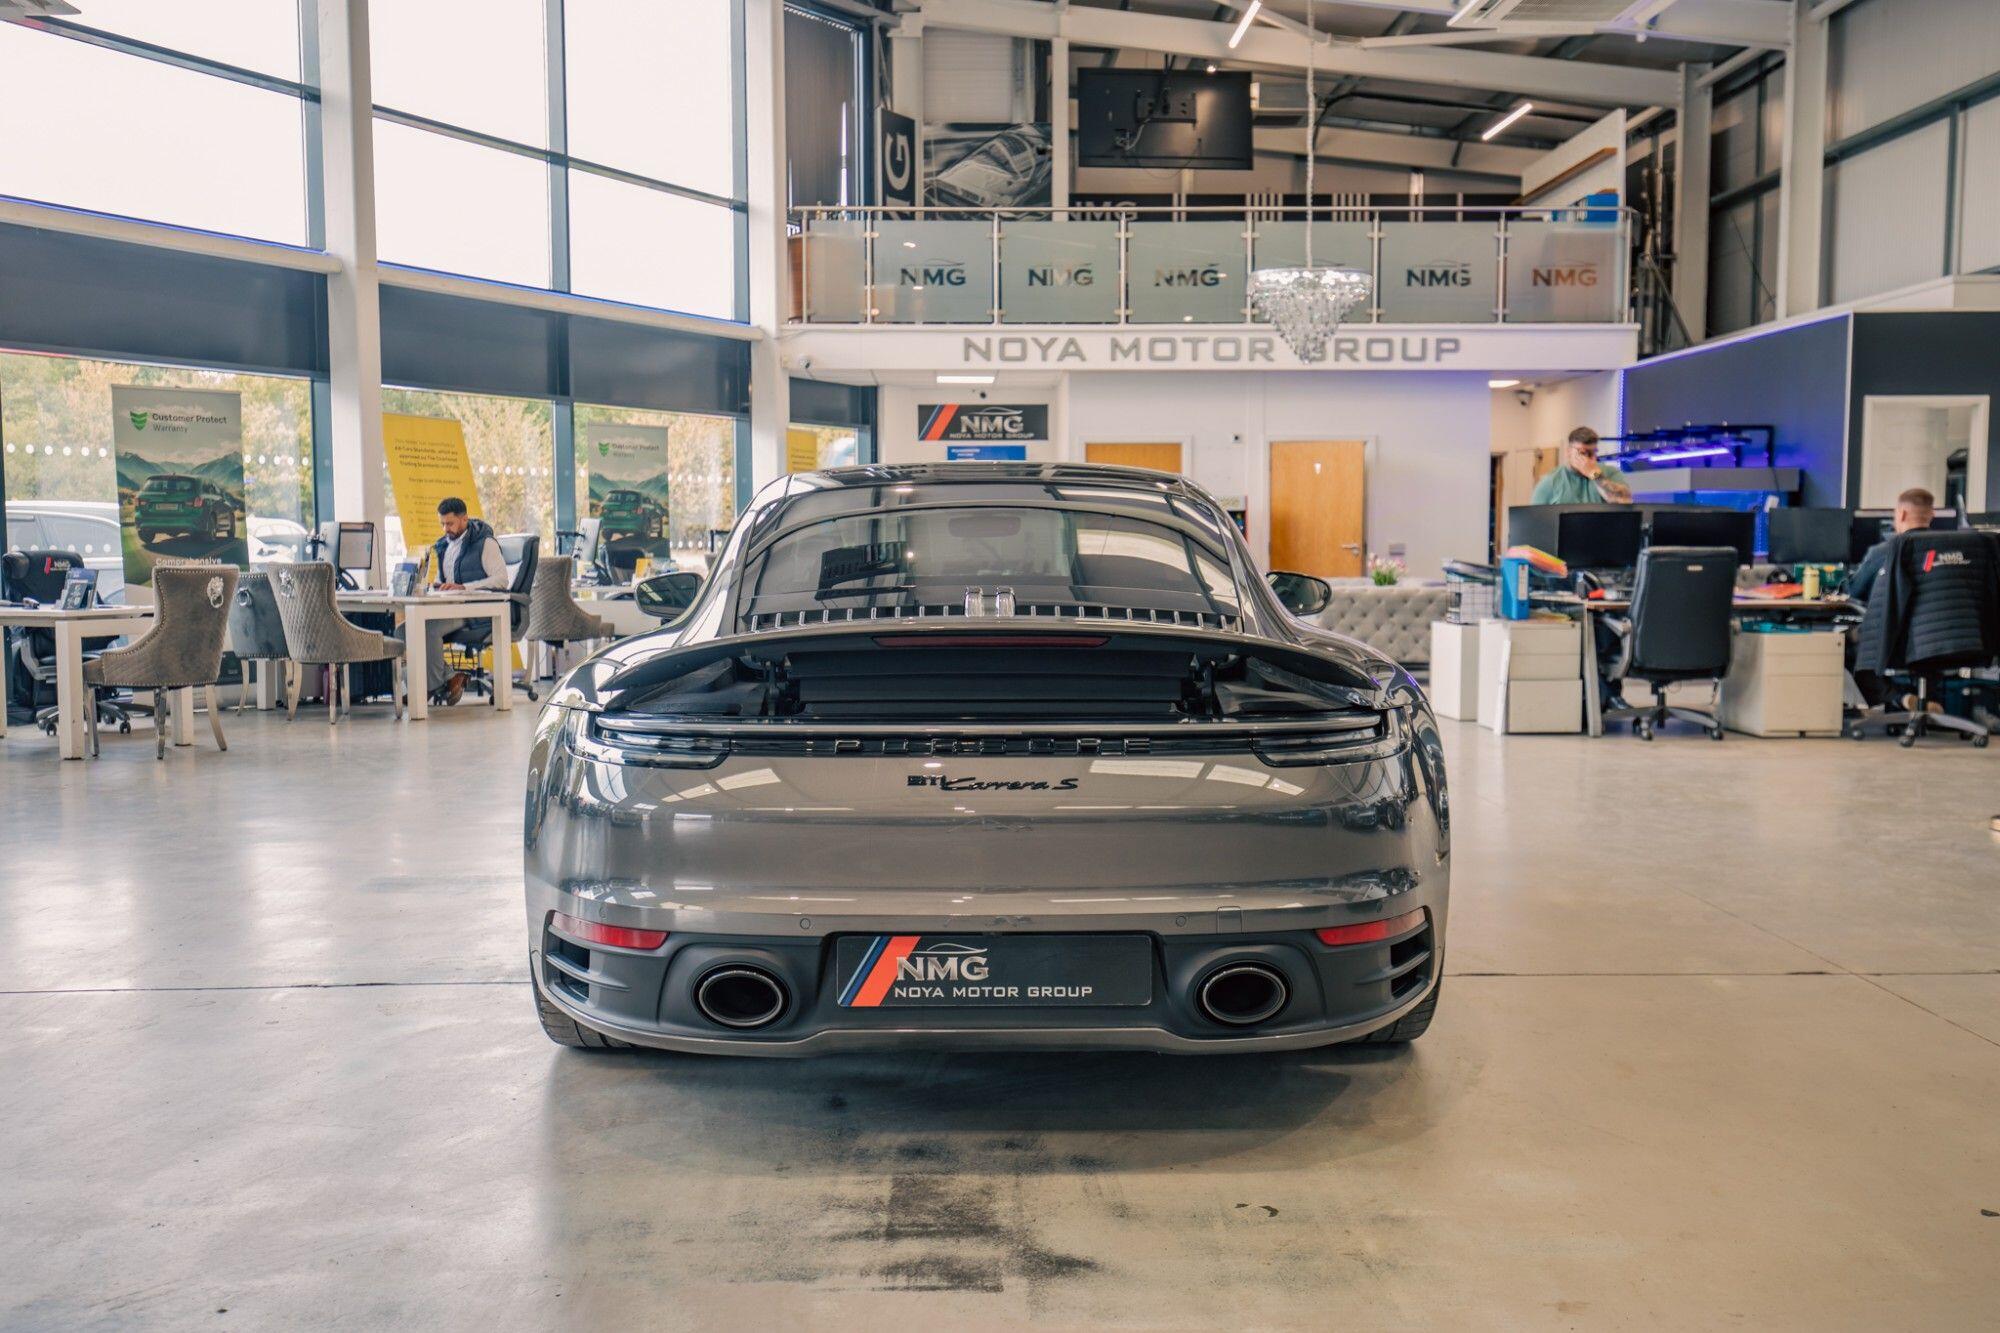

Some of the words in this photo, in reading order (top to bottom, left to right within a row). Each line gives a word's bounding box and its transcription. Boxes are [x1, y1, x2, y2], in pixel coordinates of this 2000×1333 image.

[901, 268, 966, 287] NMG
[1028, 268, 1094, 287] NMG
[1154, 268, 1220, 287] NMG
[1406, 268, 1472, 288] NMG
[1532, 268, 1598, 288] NMG
[962, 336, 1087, 363] NOYA
[1110, 336, 1276, 363] MOTOR
[151, 413, 194, 423] Customer
[196, 414, 228, 425] Protect
[153, 424, 188, 433] Warranty
[960, 415, 1024, 433] NMG
[941, 776, 1049, 791] Carrera
[1052, 778, 1079, 790] S
[896, 956, 990, 981] NMG
[894, 986, 945, 998] NOYA
[952, 986, 1019, 998] MOTOR
[1027, 986, 1093, 998] GROUP
